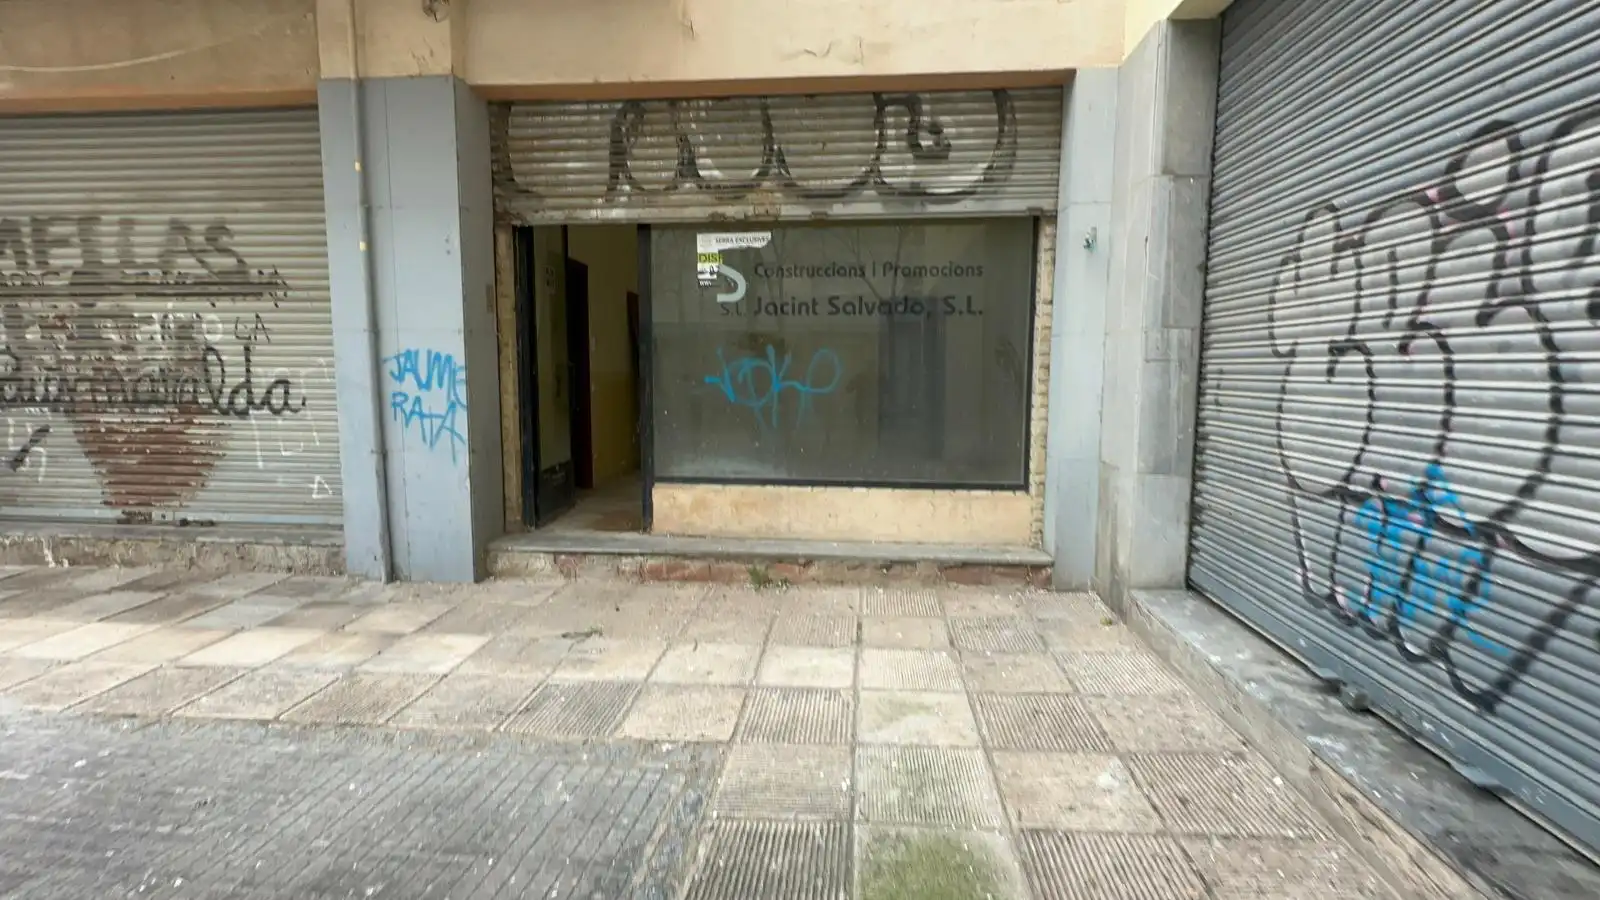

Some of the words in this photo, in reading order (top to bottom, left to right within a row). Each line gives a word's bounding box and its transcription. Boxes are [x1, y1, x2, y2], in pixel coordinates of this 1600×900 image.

[754, 261, 866, 279] Construccions
[882, 261, 985, 278] Promocions
[753, 296, 819, 317] Jacint
[943, 295, 984, 316] S.L.
